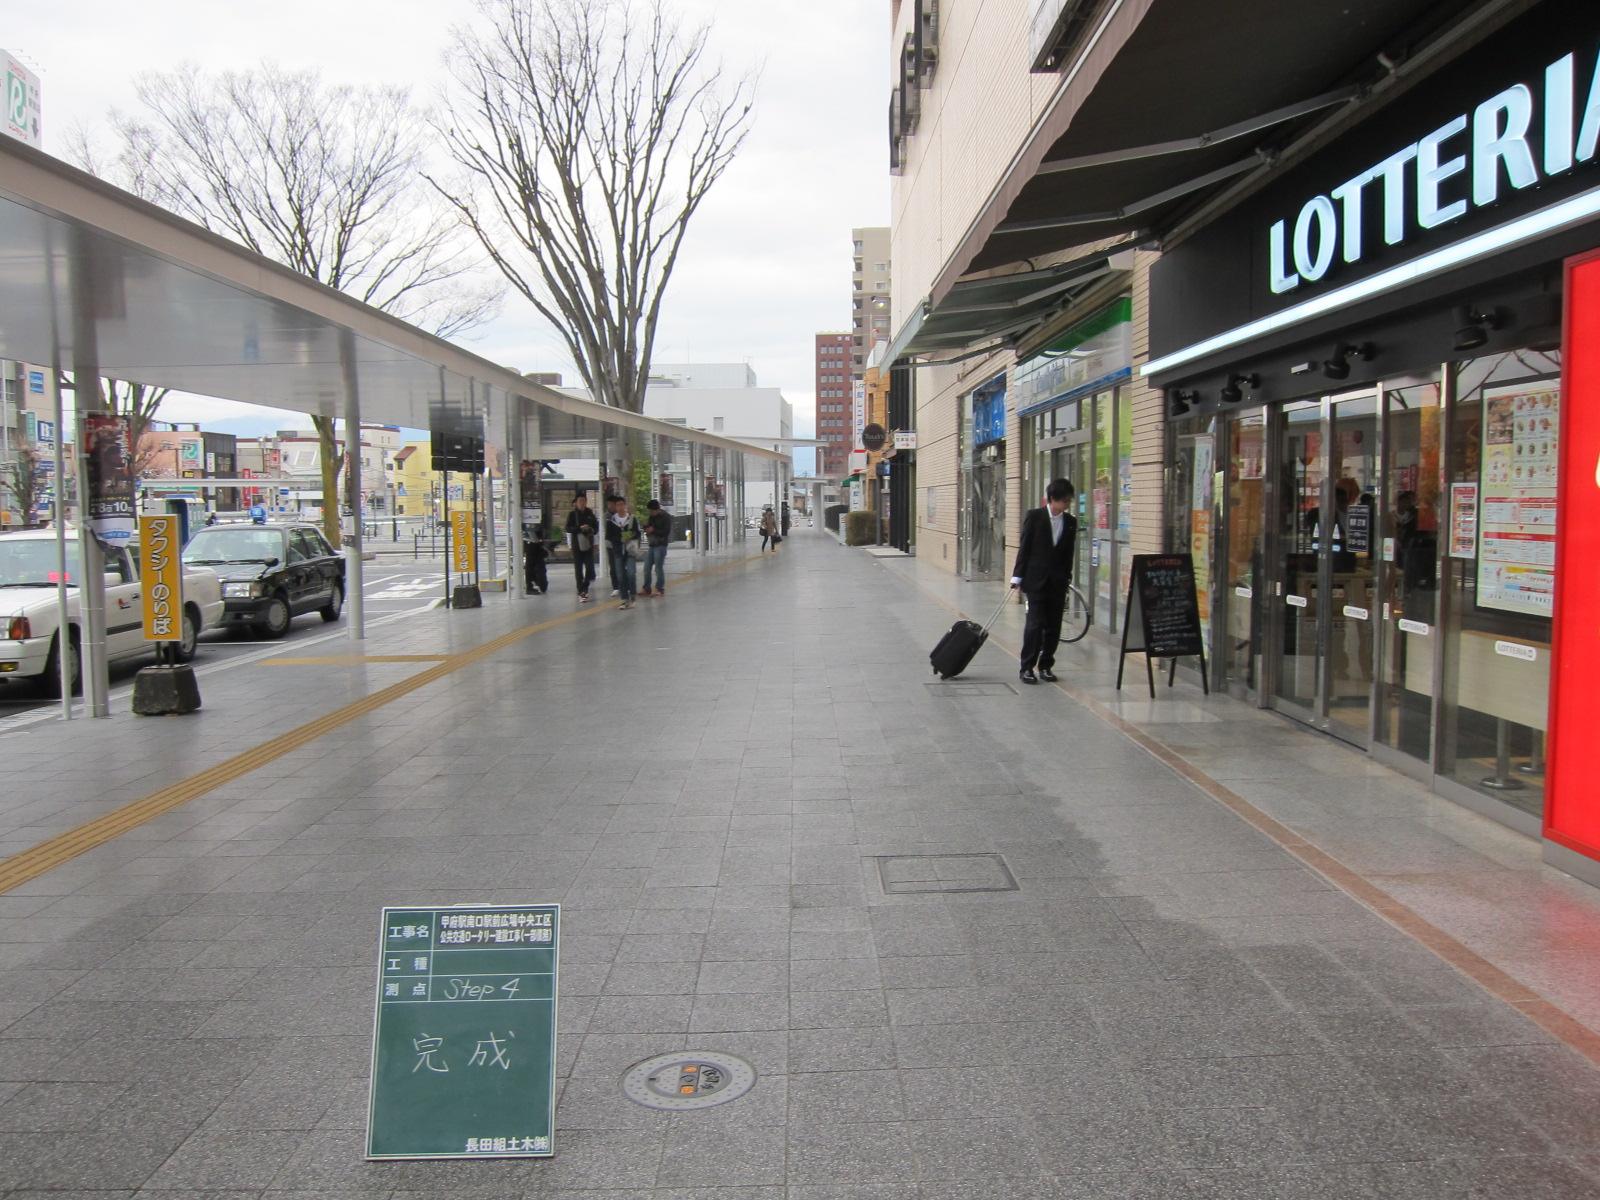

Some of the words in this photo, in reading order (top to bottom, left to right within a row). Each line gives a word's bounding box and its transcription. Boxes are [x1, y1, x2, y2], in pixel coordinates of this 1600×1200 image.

[148, 519, 171, 635] タクシーのりば
[441, 913, 552, 928] 甲府駅南口駅前広場中央工区
[388, 925, 429, 939] 工事名
[444, 978, 495, 1000] Step
[501, 977, 521, 998] 4
